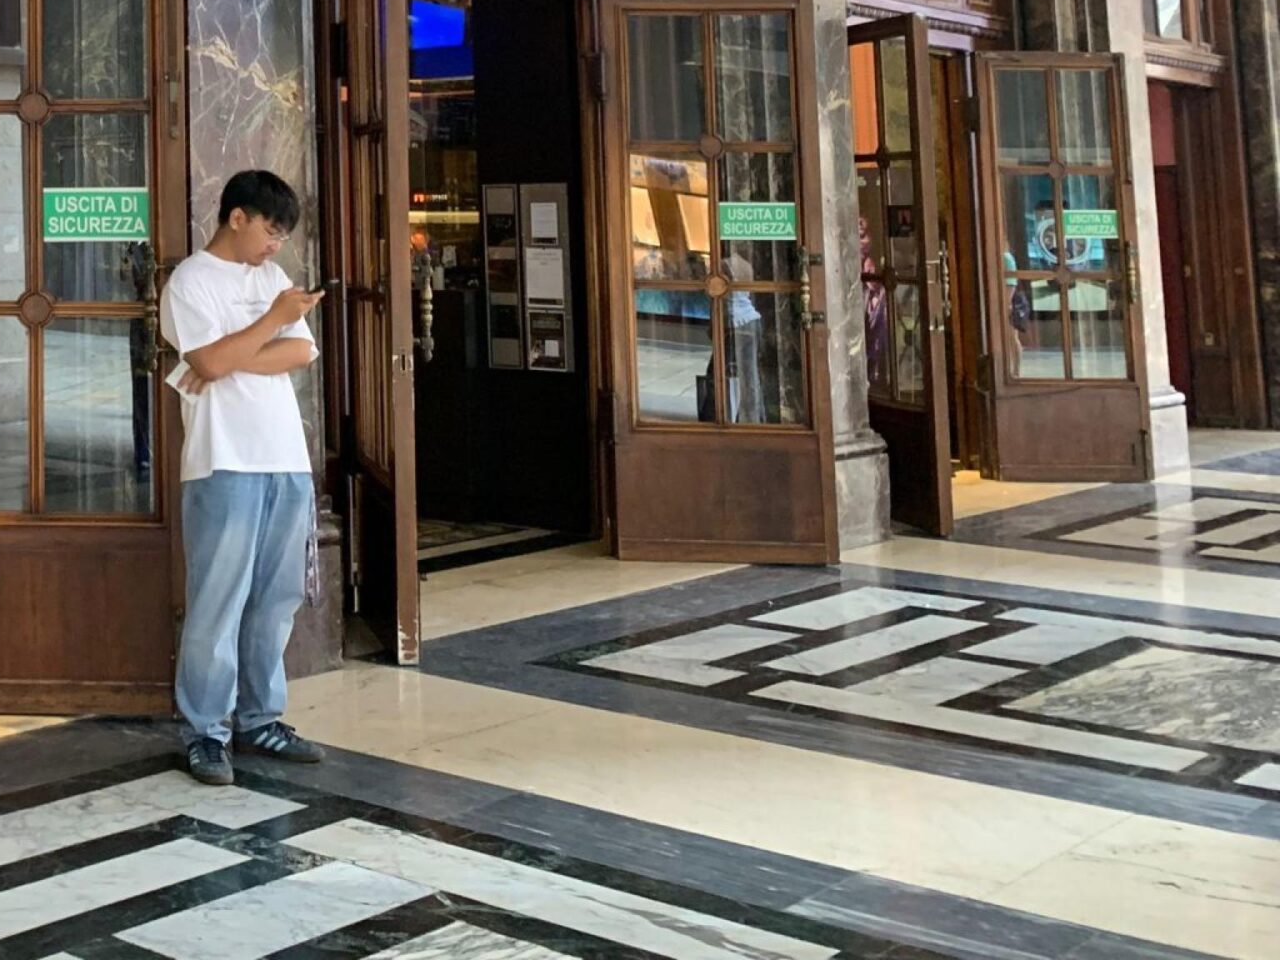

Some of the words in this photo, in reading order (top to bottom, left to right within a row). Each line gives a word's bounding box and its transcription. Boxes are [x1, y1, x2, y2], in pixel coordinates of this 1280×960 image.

[54, 196, 117, 213] USCITA
[121, 195, 138, 213] DI
[727, 207, 773, 221] USCITA
[775, 207, 788, 220] DI
[48, 216, 146, 233] SICUREZZA
[723, 221, 794, 235] SICUREZZA
